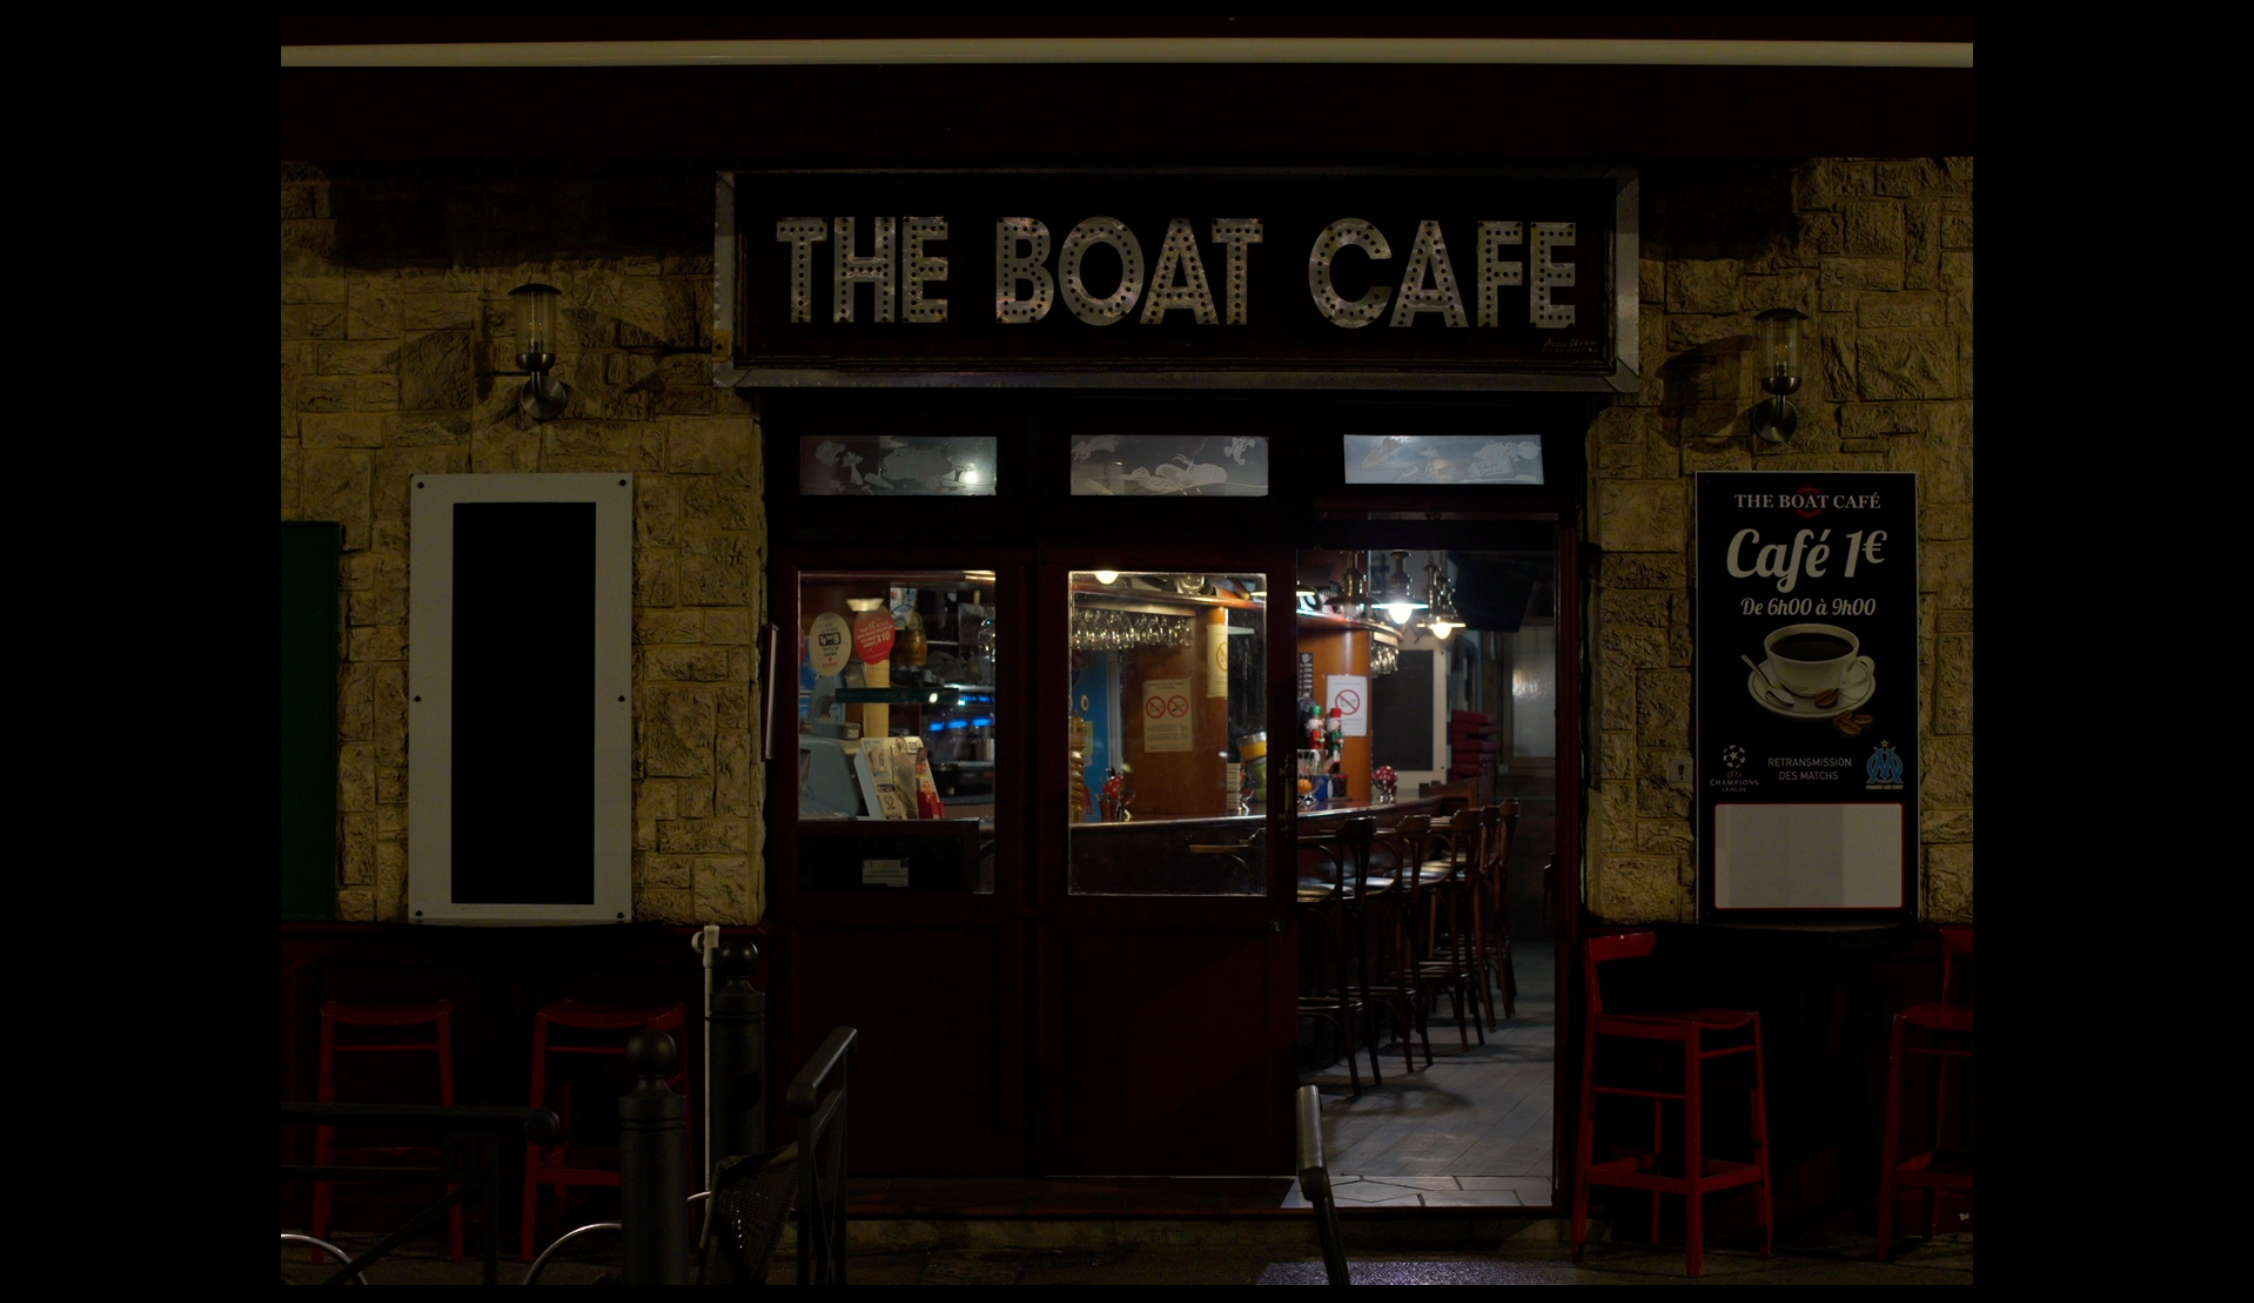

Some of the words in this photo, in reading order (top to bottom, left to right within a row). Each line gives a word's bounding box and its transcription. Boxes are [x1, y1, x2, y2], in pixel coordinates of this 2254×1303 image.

[776, 216, 949, 325] THE
[995, 215, 1264, 327] BOAT
[1308, 217, 1577, 330] CAFE
[1733, 494, 1774, 509] THE
[1778, 494, 1830, 509] BOAT
[1832, 492, 1881, 509] CAFÉ
[1726, 528, 1832, 594] Café
[1843, 528, 1889, 579] 1€
[1740, 598, 1764, 617] De
[1767, 597, 1813, 617] 6h00
[1815, 598, 1829, 617] à
[1832, 597, 1877, 617] 9h00
[833, 634, 840, 644] 5
[878, 753, 885, 766] 6
[1767, 757, 1852, 768] RETRANSMISSION
[1778, 770, 1798, 781] DES
[1800, 770, 1839, 781] MATCHS
[1709, 779, 1760, 787] CHAMPIONS
[884, 796, 896, 810] 52
